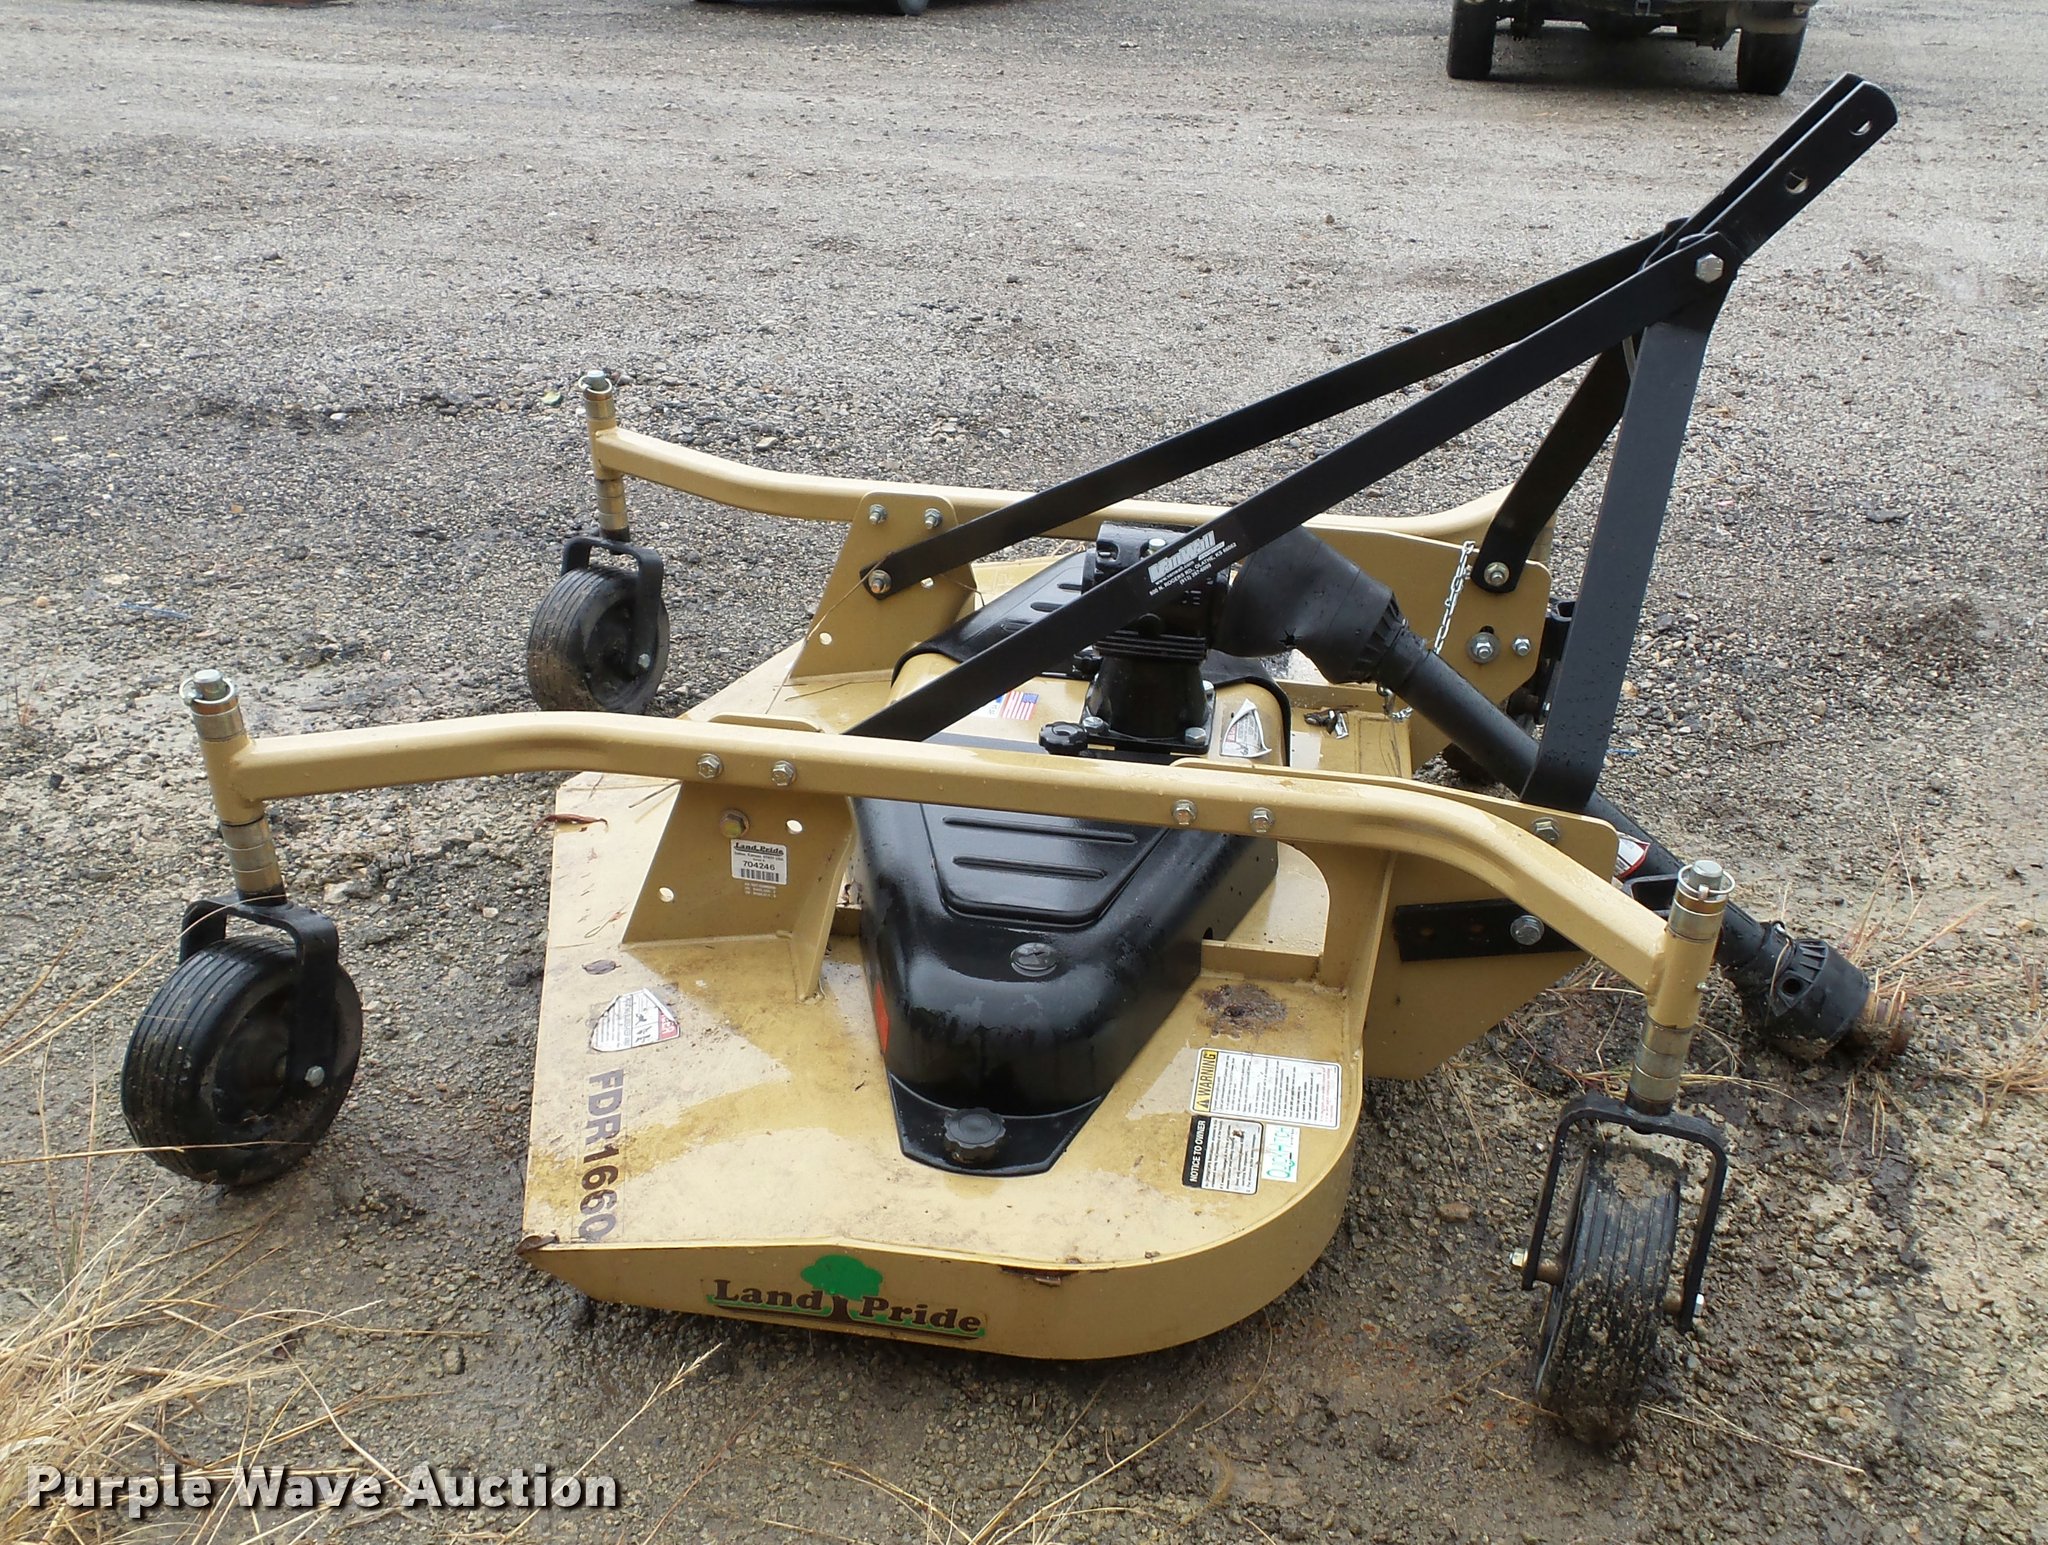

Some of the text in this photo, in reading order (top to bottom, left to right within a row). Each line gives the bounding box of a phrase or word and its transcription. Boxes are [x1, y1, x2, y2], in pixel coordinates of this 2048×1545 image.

[735, 842, 758, 852] Land
[760, 845, 784, 856] Pride
[743, 860, 776, 871] 704246
[1198, 1051, 1216, 1098] WARNING
[578, 1068, 625, 1242] FDR1660
[1189, 1120, 1206, 1183] NOTICE TO OWNER
[713, 1279, 982, 1332] Land Pride
